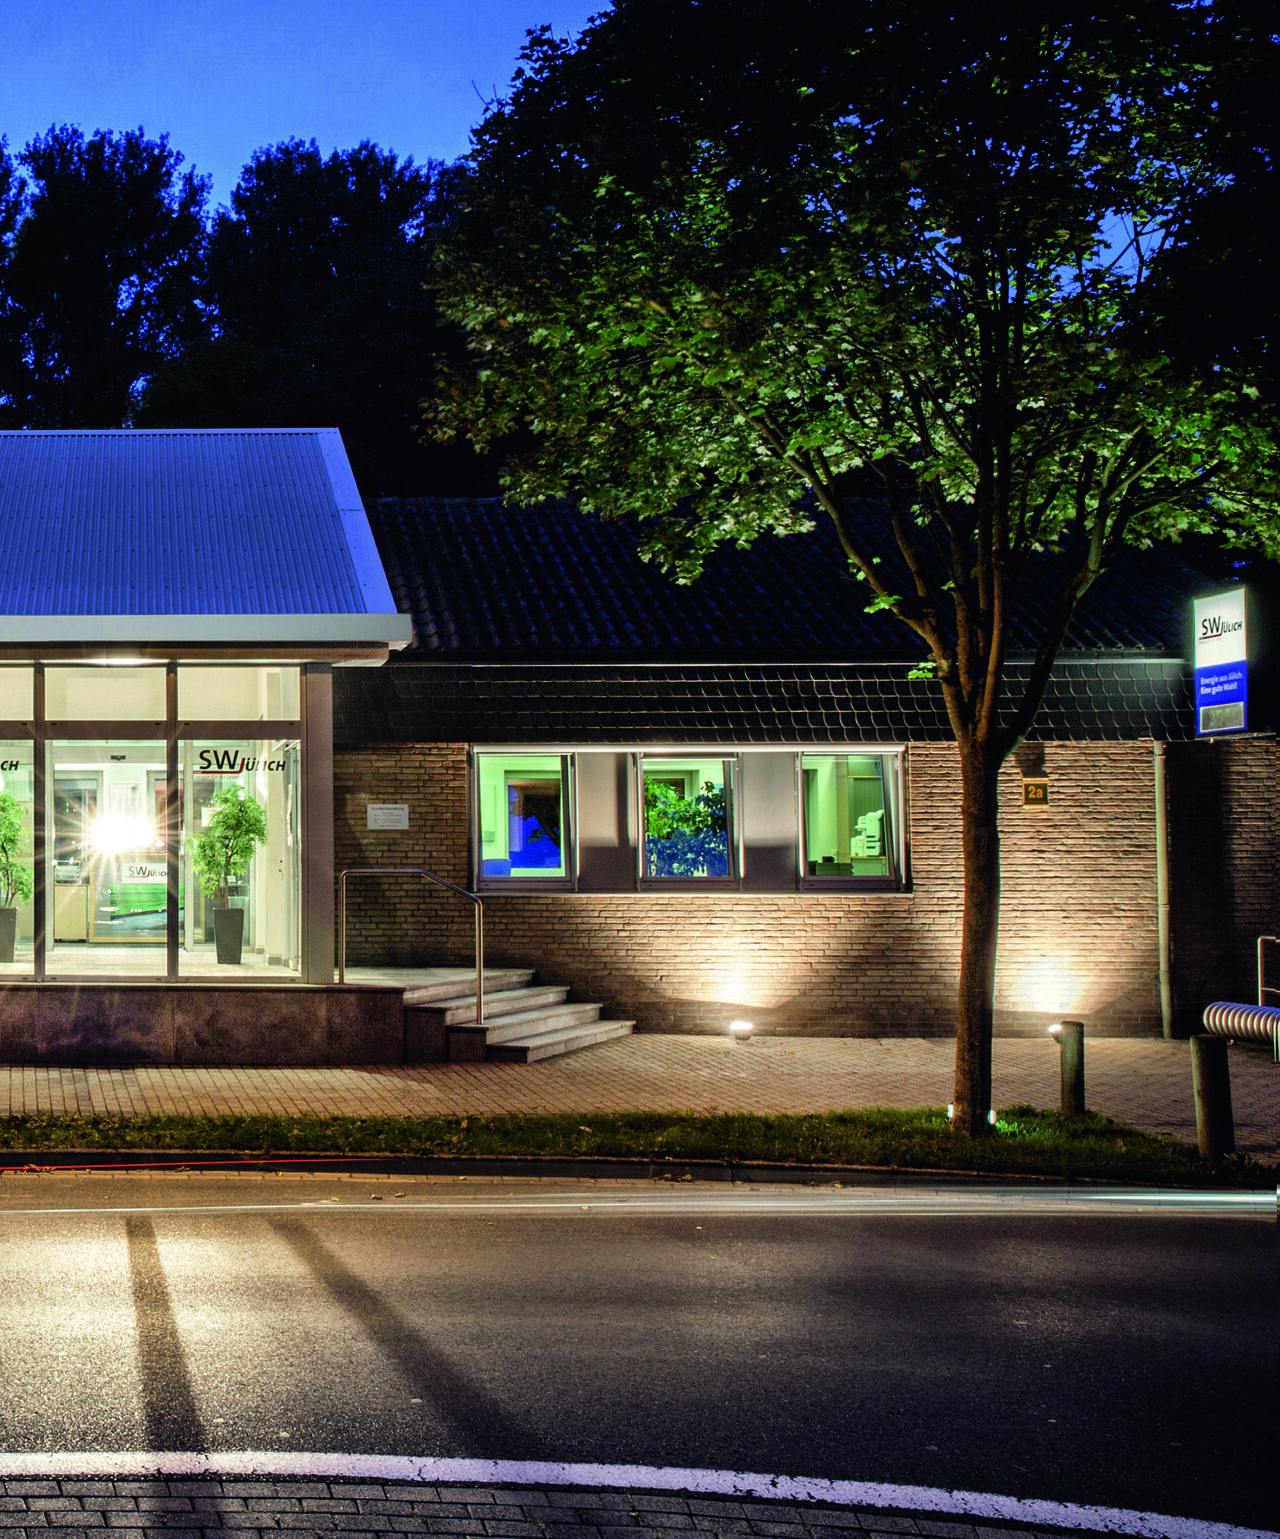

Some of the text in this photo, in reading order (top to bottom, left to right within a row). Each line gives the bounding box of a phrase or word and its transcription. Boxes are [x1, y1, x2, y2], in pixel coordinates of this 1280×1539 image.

[1200, 686, 1212, 695] Eine
[1211, 684, 1224, 696] gute
[1028, 785, 1043, 798] 2a
